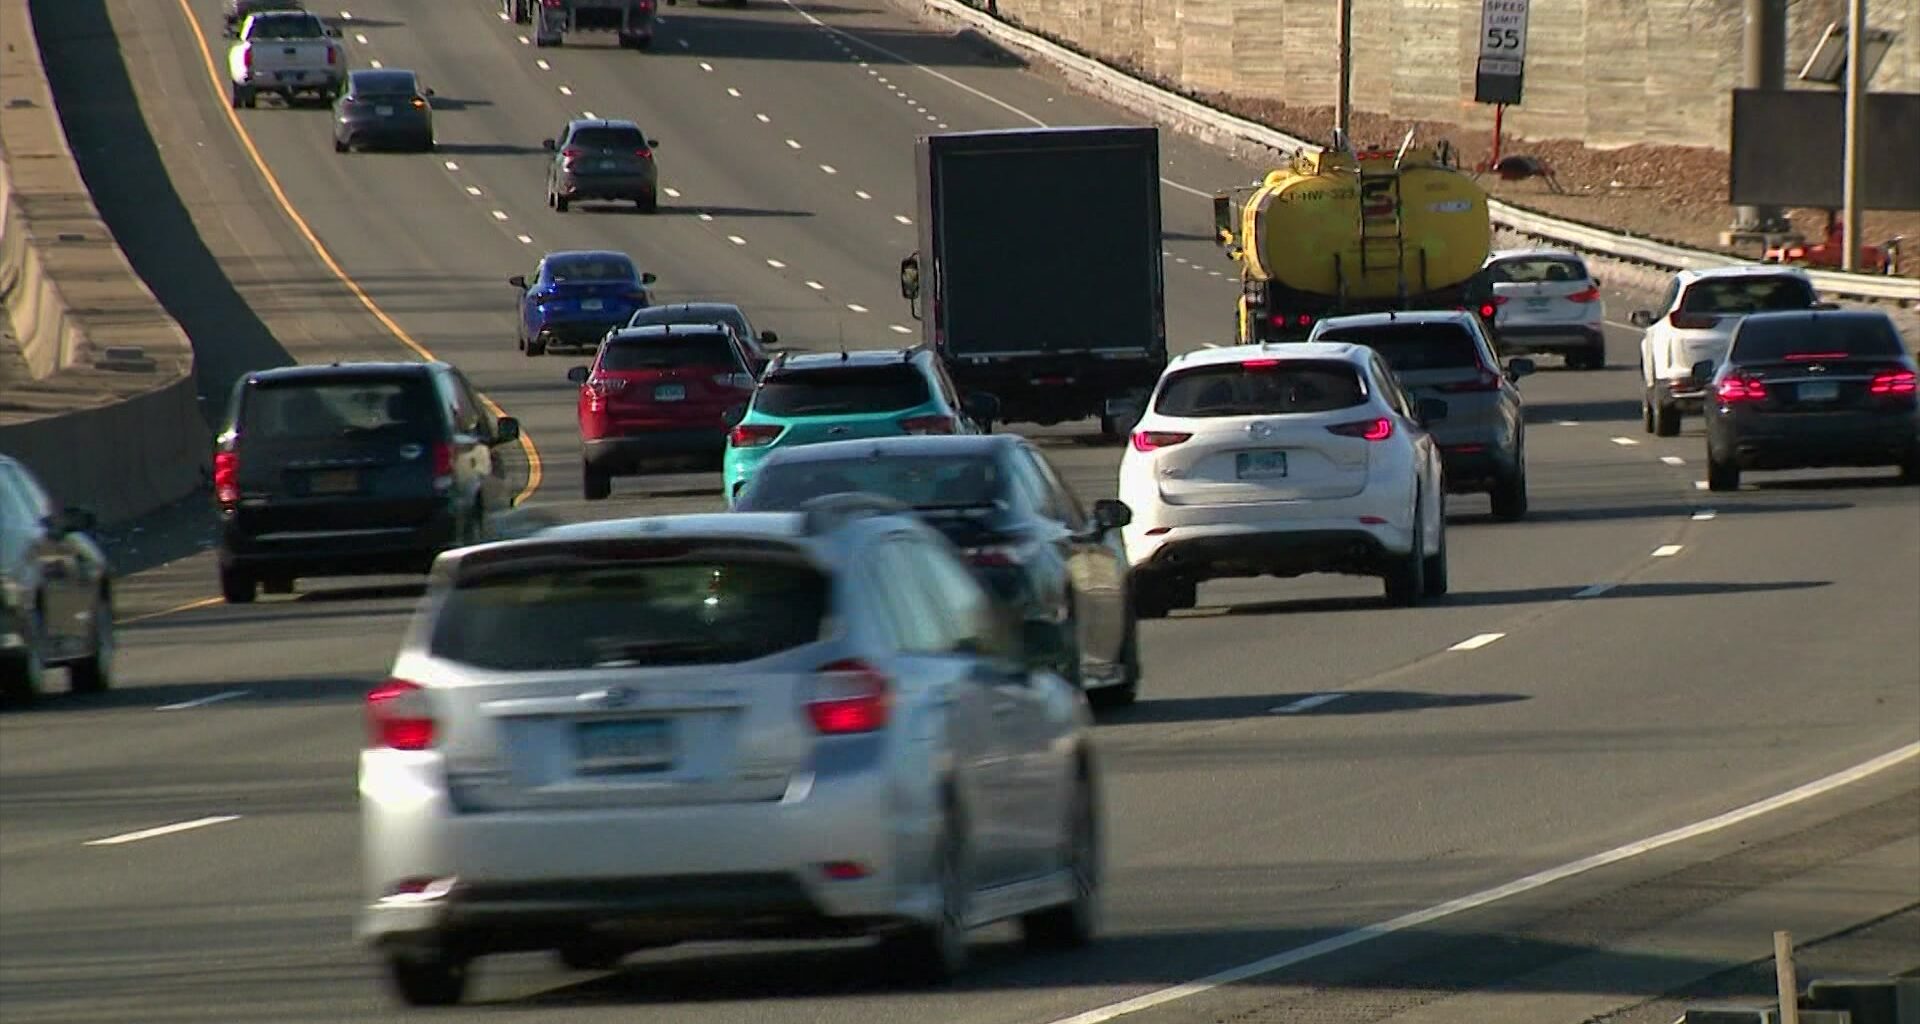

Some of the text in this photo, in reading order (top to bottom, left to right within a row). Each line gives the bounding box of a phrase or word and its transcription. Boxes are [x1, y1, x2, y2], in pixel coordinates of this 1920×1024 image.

[1488, 0, 1525, 12] SPEED
[1489, 15, 1520, 24] LIMIT
[1487, 27, 1520, 50] 55
